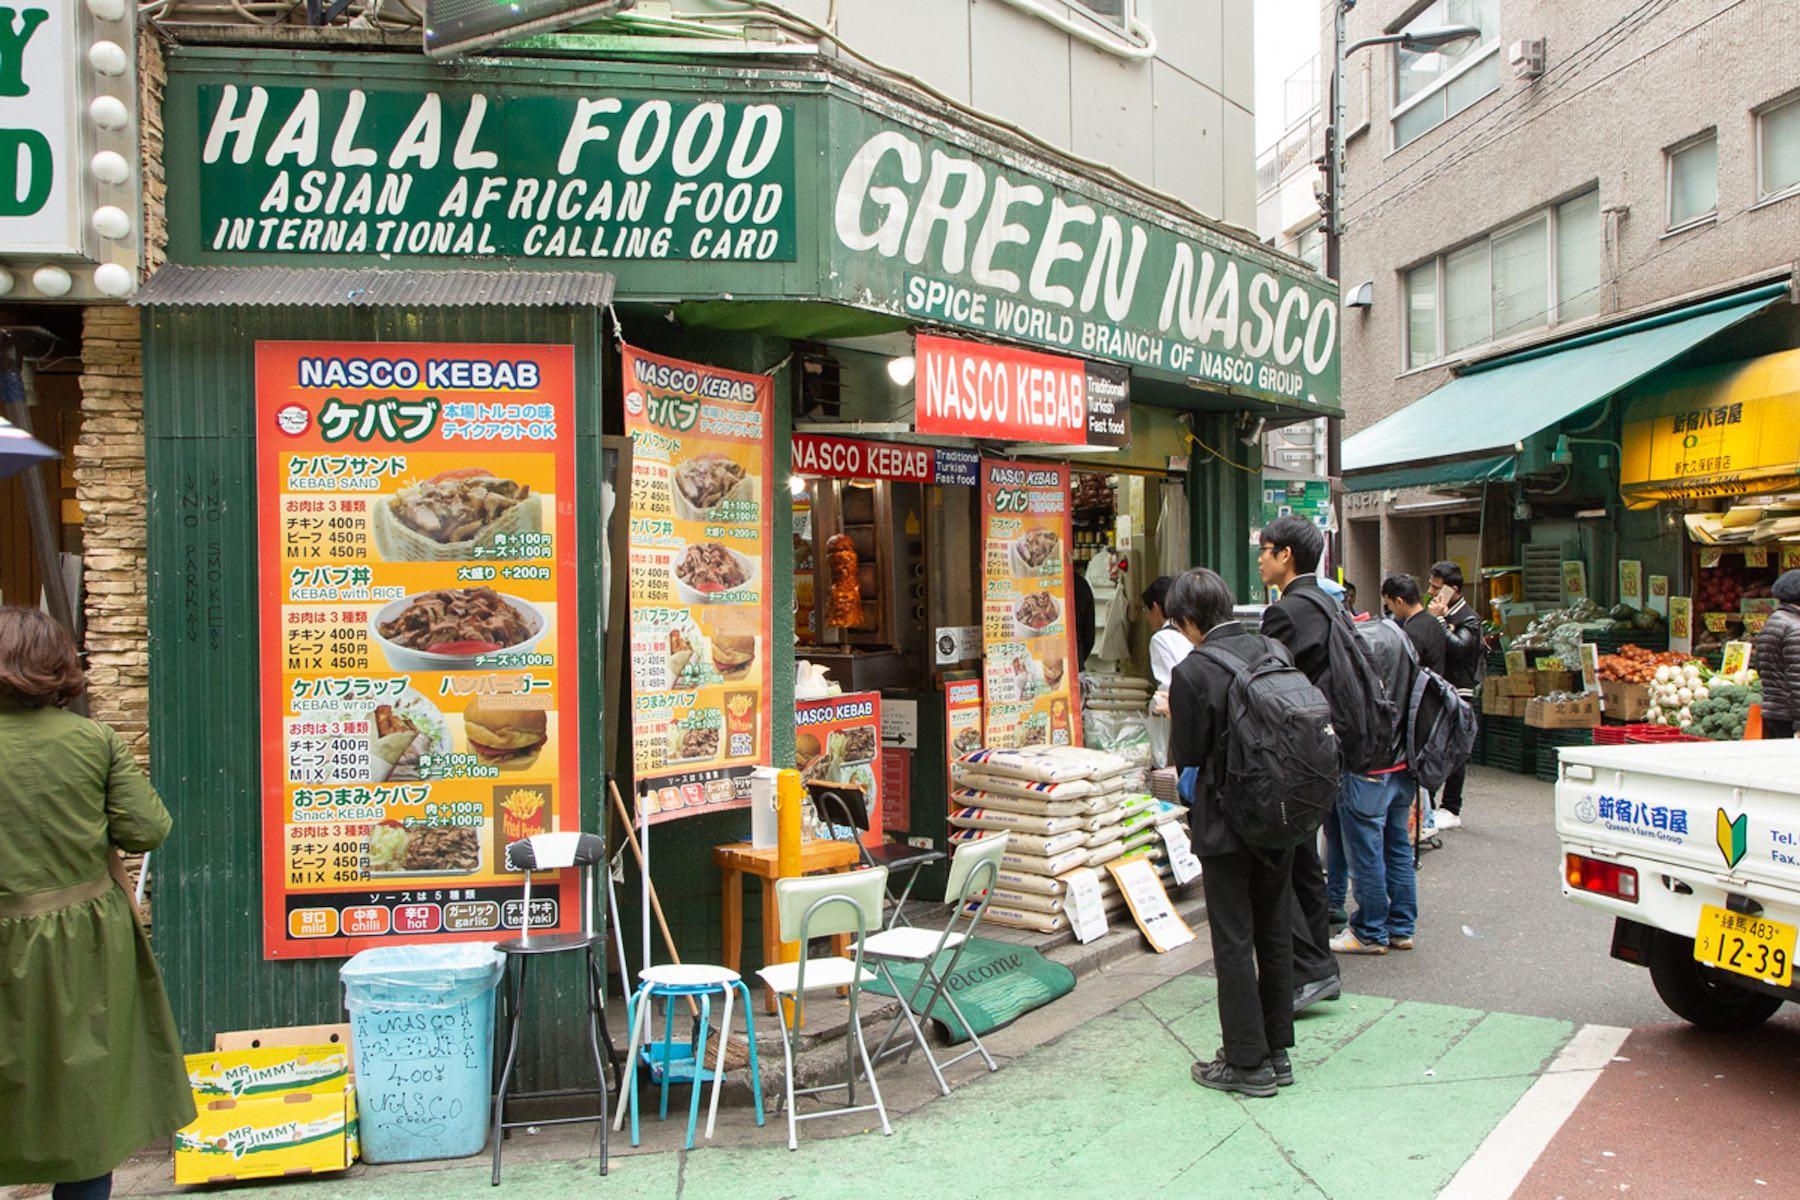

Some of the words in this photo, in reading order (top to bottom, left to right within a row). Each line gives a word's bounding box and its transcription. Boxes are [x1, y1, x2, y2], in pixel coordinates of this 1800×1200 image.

[203, 84, 499, 170] HALAL
[558, 97, 783, 178] FOOD
[260, 171, 411, 216] ASIAN
[440, 179, 647, 223] AFRICAN
[664, 182, 783, 225] FOOD
[213, 217, 496, 255] INTERNATIONAL
[523, 221, 671, 258] CALLING
[690, 227, 779, 260] CARD
[835, 131, 1147, 322] GREEN
[1159, 242, 1336, 373] NASCO
[907, 277, 986, 324] SPICE
[994, 301, 1072, 344] WORLD
[1081, 322, 1162, 369] BRANCH
[1170, 341, 1194, 370] OF
[1200, 349, 1253, 385] NASCO
[1258, 367, 1303, 396] GROUP
[299, 359, 419, 388] NASCO
[427, 361, 539, 389] KEBAB
[635, 360, 699, 394] NASCO
[699, 375, 756, 402] KEBAB
[926, 352, 1007, 423] NASCO
[1017, 367, 1084, 430] KEBAB
[1087, 376, 1125, 398] Traditional
[444, 404, 554, 420] 本場トルコの味
[647, 394, 698, 430] ケバブ
[1087, 398, 1116, 415] Turkish
[319, 398, 438, 441] ケバブ
[1088, 418, 1107, 433] Fast
[1109, 419, 1125, 434] food
[443, 424, 556, 439] テイクアウトOK
[792, 440, 859, 473] NASCO
[868, 448, 928, 478] KEBAB
[936, 450, 979, 463] Traditional
[289, 457, 406, 476] ケバブサンド
[936, 462, 967, 472] Turkish
[290, 478, 337, 489] KEBAB
[340, 478, 379, 489] SAND
[936, 475, 955, 484] Fast
[957, 475, 976, 485] food
[287, 518, 324, 530] チキン
[328, 517, 366, 530] 400円
[287, 532, 322, 544] ビーフ
[329, 532, 366, 544] 450円
[287, 546, 321, 558] MIX
[330, 546, 367, 558] 450円
[291, 566, 371, 586] ケバブ丼
[458, 567, 495, 580] 大盛り
[291, 588, 337, 599] KEBAB
[341, 588, 371, 599] with
[373, 587, 404, 598] RICE
[288, 629, 325, 641] チキン
[330, 629, 367, 640] 400円
[289, 643, 323, 655] ビーフ
[331, 643, 367, 655] 450円
[289, 657, 322, 669] MIX
[331, 657, 368, 669] 450円
[292, 677, 409, 697] ケバブラップ
[292, 700, 339, 711] KEBAB
[342, 701, 375, 713] wrap
[795, 707, 834, 726] NASCO
[836, 700, 873, 719] KEBAB
[290, 740, 327, 751] チキン
[331, 740, 368, 751] 400円
[290, 755, 324, 766] ビーフ
[332, 754, 368, 766] 450円
[290, 769, 323, 780] MIX
[332, 768, 369, 780] 450円
[294, 786, 429, 807] おつまみケバブ
[293, 808, 333, 821] Snack
[338, 807, 384, 819] KEBAB
[1598, 795, 1689, 835] 新宿八百屋
[1770, 830, 1797, 845] Tel.
[291, 843, 329, 855] チキン
[333, 842, 370, 854] 400円
[291, 857, 327, 869] ビーフ
[333, 856, 370, 868] 450円
[1772, 850, 1800, 866] Fax.
[292, 871, 325, 883] MIX
[333, 870, 370, 882] 450円
[302, 911, 326, 923] 甘口
[354, 909, 378, 920] 中辛
[405, 906, 429, 918] 辛口
[449, 905, 494, 917] ガーリック
[301, 923, 327, 933] mild
[351, 920, 380, 932] chilli
[407, 918, 427, 929] hot
[455, 914, 489, 928] garlic
[1720, 915, 1747, 934] 練馬
[1749, 921, 1775, 941] 483
[1717, 933, 1786, 979] 12-39
[225, 1065, 250, 1080] MR
[245, 1061, 297, 1085] JIMMY
[228, 1126, 253, 1141] MR
[249, 1121, 298, 1145] JIMMY
